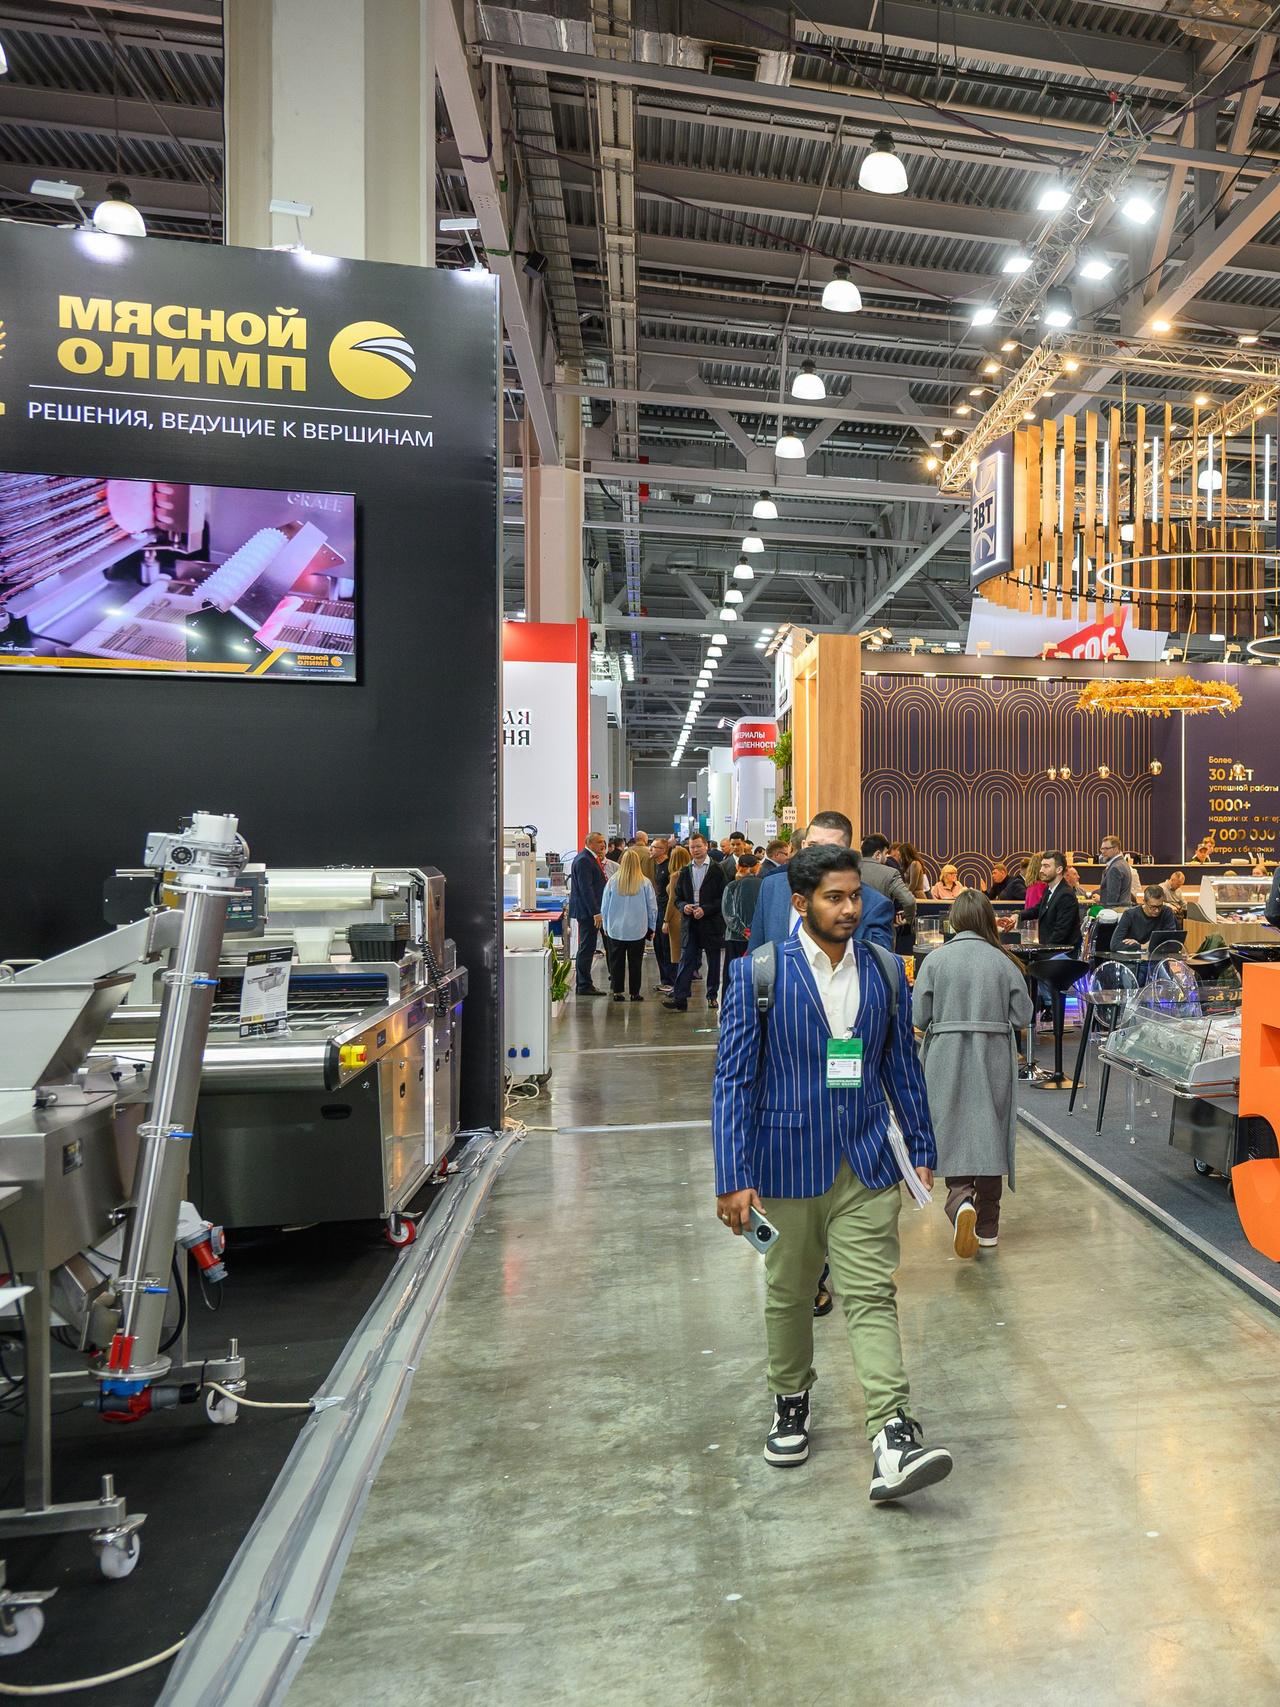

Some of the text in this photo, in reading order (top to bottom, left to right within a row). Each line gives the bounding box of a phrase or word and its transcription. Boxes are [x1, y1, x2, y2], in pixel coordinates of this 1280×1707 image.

[58, 294, 307, 350] МЯСНОЙ
[57, 337, 307, 392] ОЛИМП
[28, 401, 434, 448] РЕШЕНИЯ, ВЕДУЩИЕ К ВЕРШИНАМ
[1208, 756, 1233, 764] Более
[1208, 768, 1226, 781] 30
[1209, 784, 1279, 793] успешной работы
[1208, 798, 1251, 812] 1000+
[1219, 828, 1246, 841] 000
[1249, 828, 1276, 841] 000
